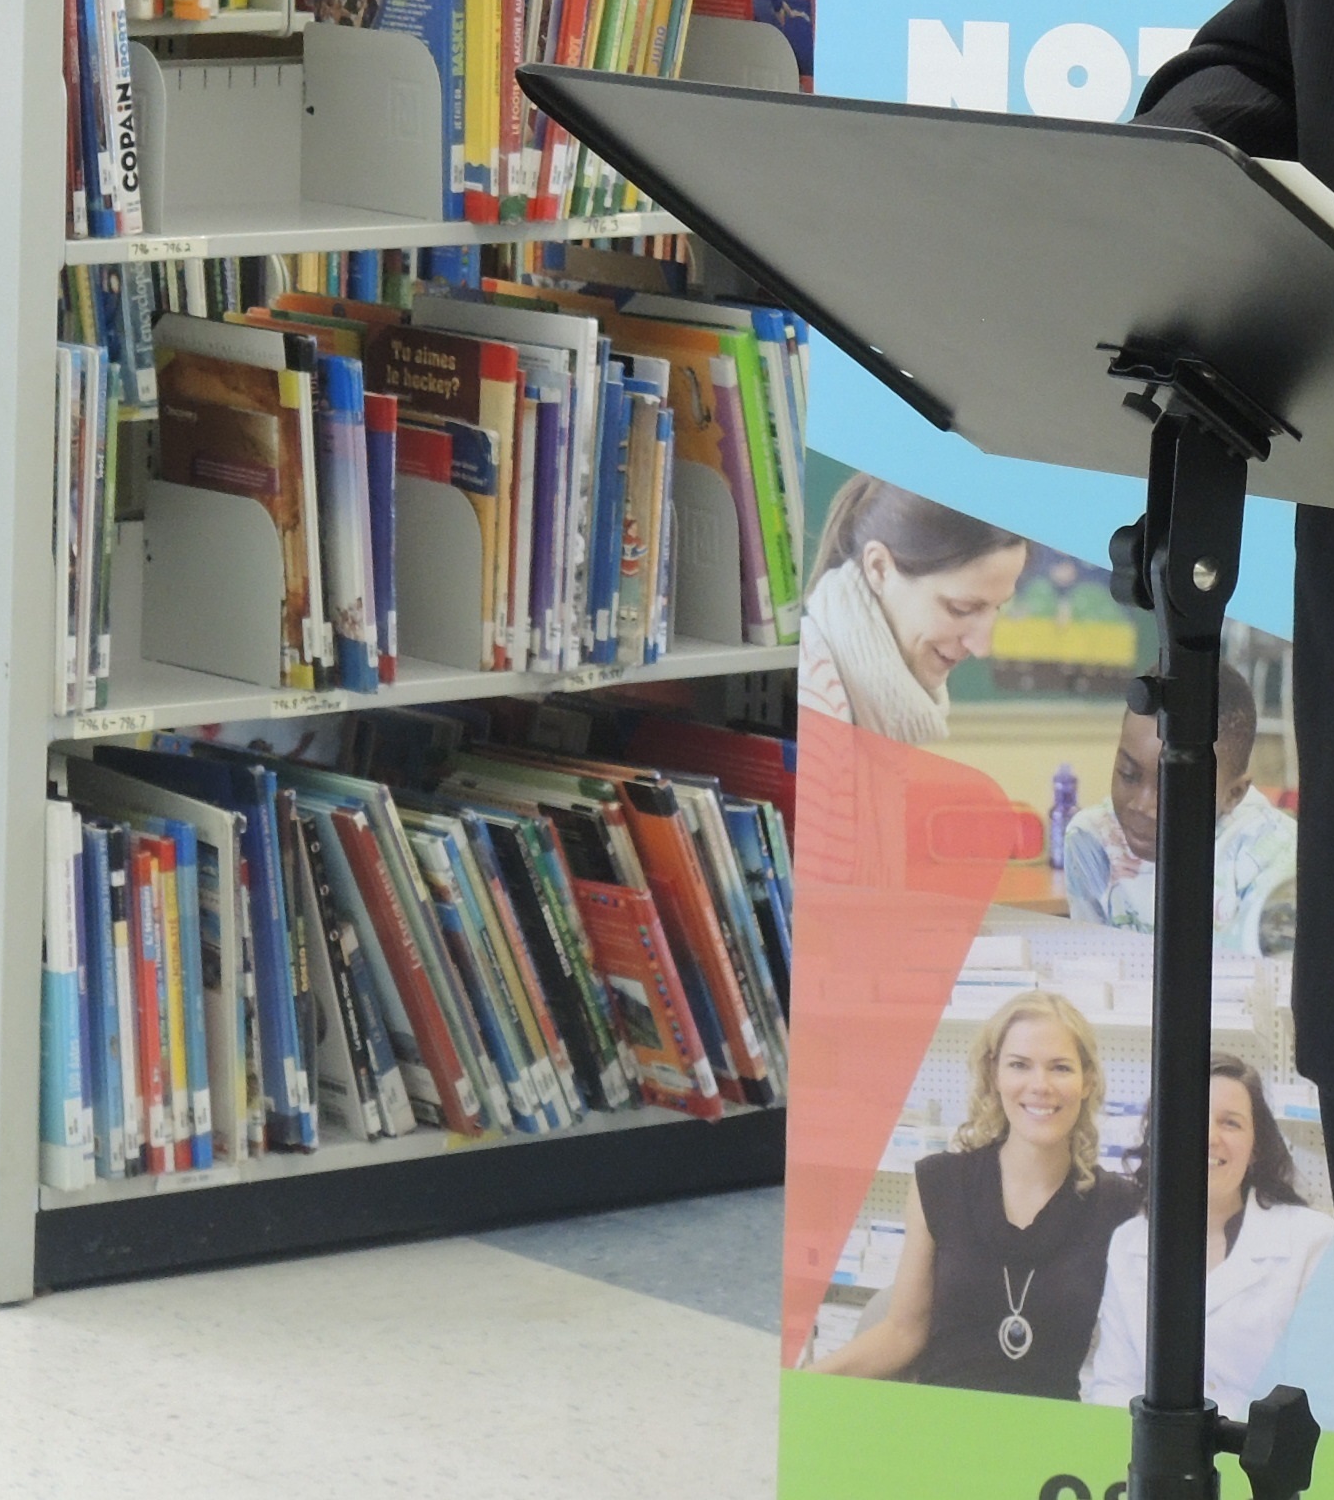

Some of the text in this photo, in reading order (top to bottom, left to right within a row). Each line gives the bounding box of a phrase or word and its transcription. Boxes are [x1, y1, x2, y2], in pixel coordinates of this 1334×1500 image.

[117, 9, 130, 79] SPORTS
[452, 11, 464, 76] BASKET
[390, 338, 456, 372] Tu aimes
[386, 363, 460, 401] le hockey?
